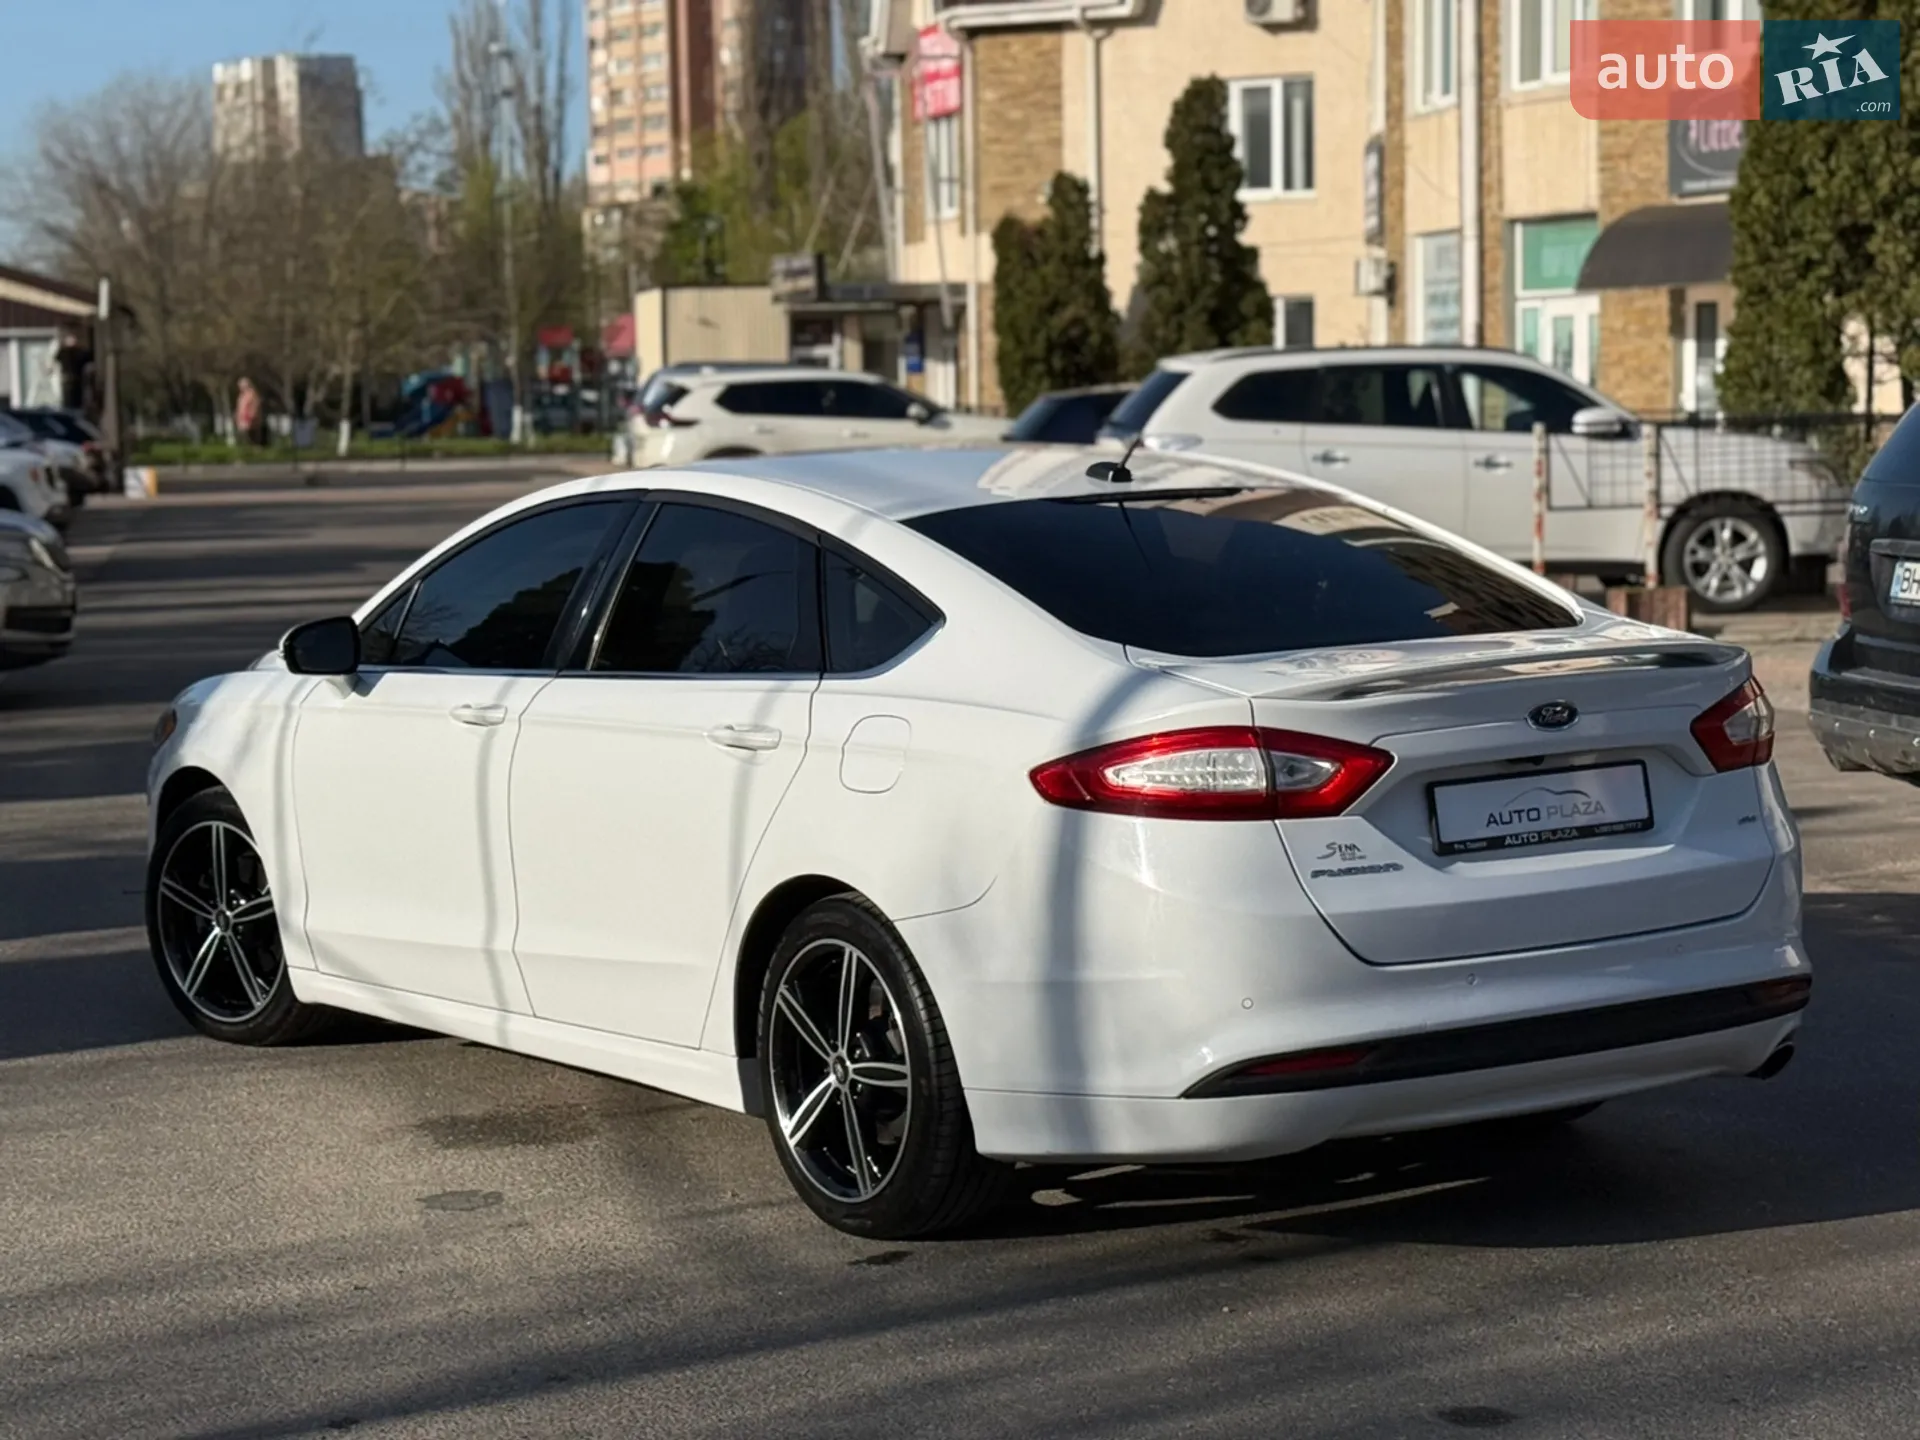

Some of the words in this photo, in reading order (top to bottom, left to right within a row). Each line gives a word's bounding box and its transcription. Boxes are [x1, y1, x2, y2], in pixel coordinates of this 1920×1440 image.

[1486, 806, 1541, 828] AUTO
[1546, 800, 1606, 820] PLAZA
[1504, 831, 1540, 846] AUTO
[1541, 828, 1580, 841] PLAZA
